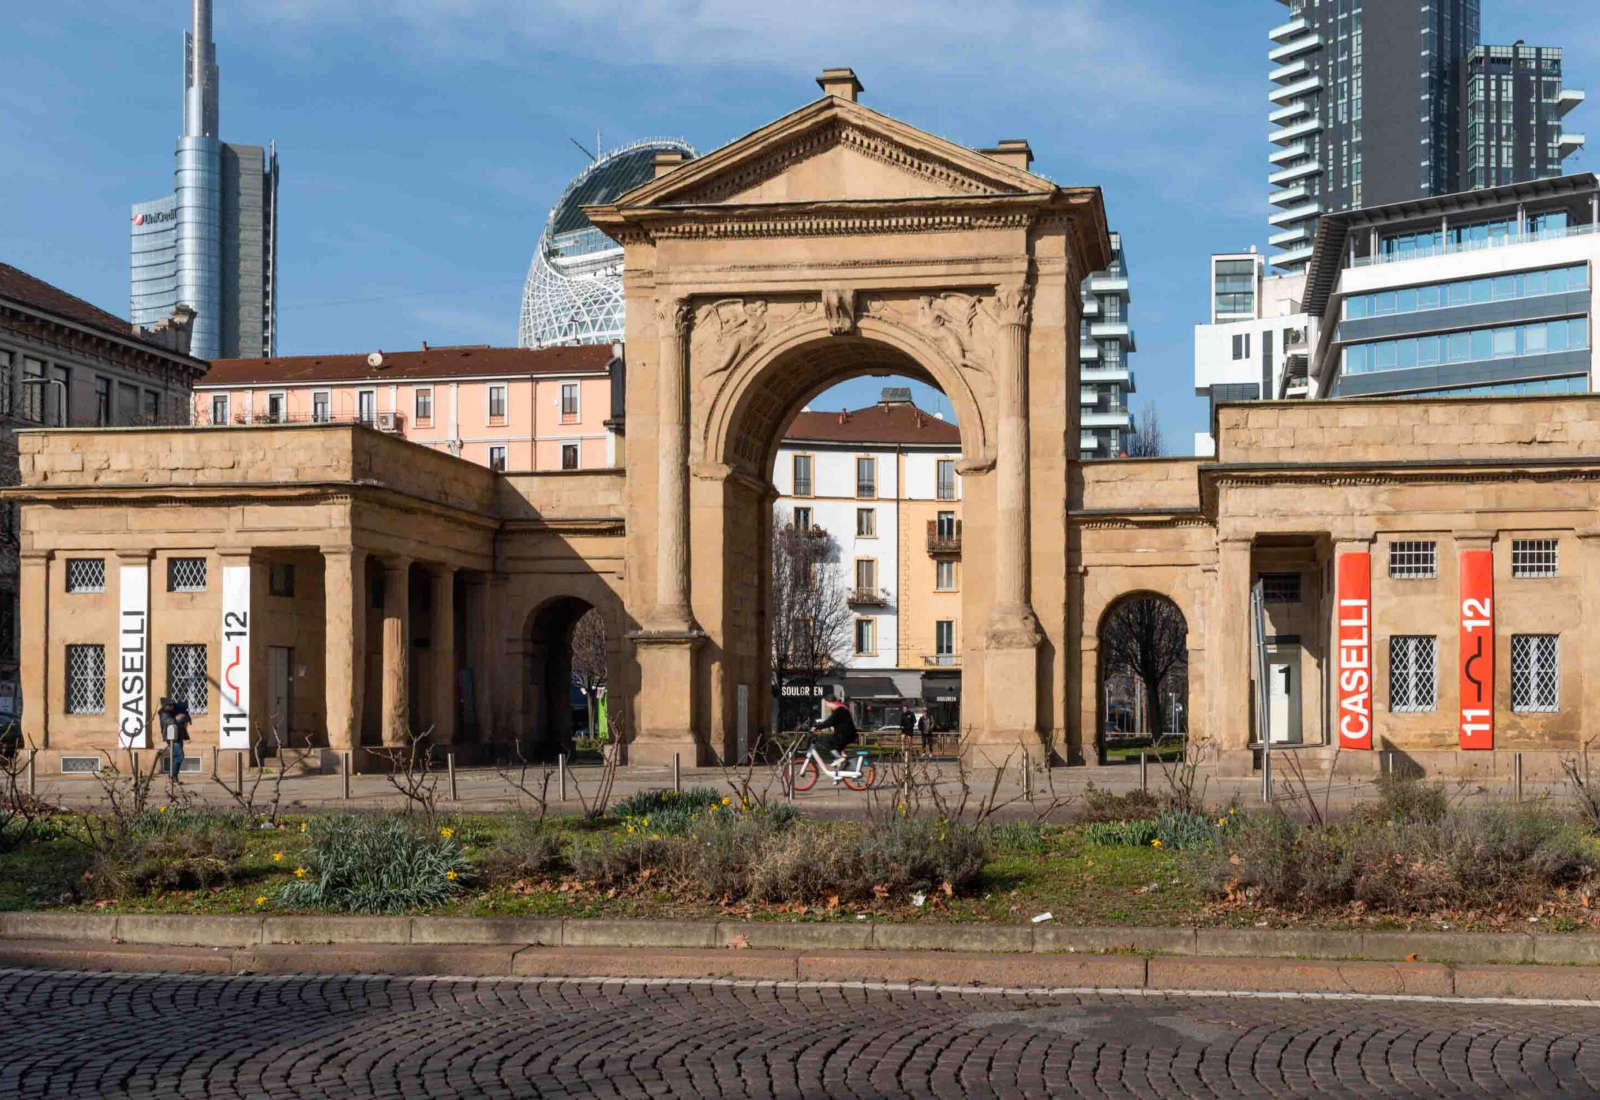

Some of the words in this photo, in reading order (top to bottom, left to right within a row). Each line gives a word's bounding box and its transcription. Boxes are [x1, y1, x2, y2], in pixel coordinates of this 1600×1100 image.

[224, 611, 247, 641] 12
[1462, 598, 1490, 632] 12
[121, 610, 145, 737] CASELLI
[1340, 599, 1368, 739] CASELLI
[781, 686, 824, 696] SOULGREN
[223, 713, 247, 736] 11
[1462, 709, 1490, 736] 11
